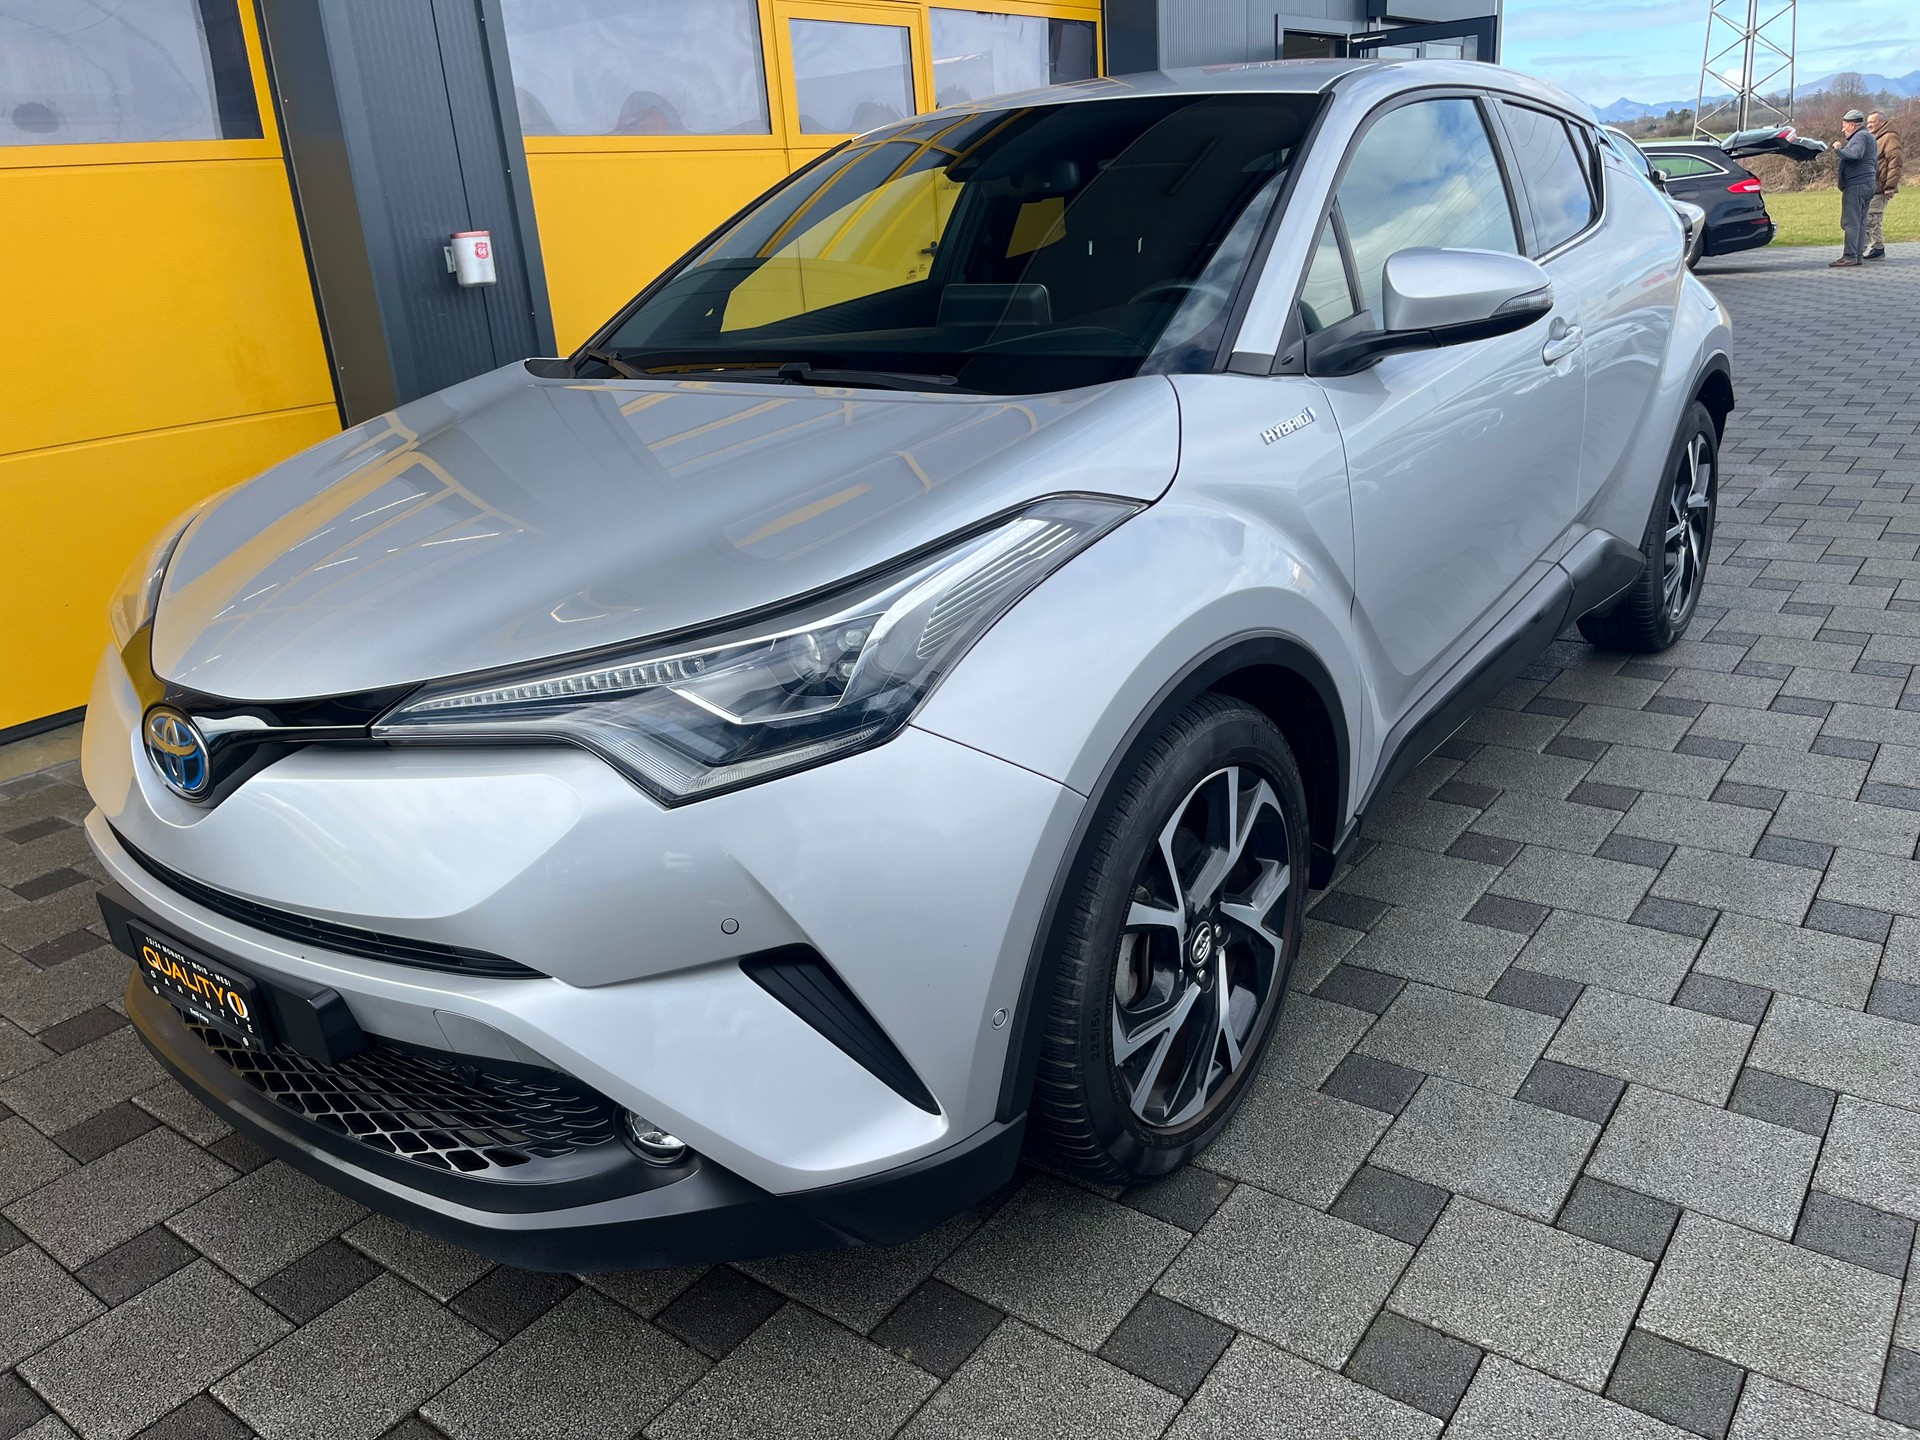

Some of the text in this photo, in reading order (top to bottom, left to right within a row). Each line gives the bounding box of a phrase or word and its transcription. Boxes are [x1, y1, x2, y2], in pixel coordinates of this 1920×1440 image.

[477, 247, 487, 255] 66
[1260, 411, 1312, 445] HYBRID
[143, 945, 224, 1006] QUALITY
